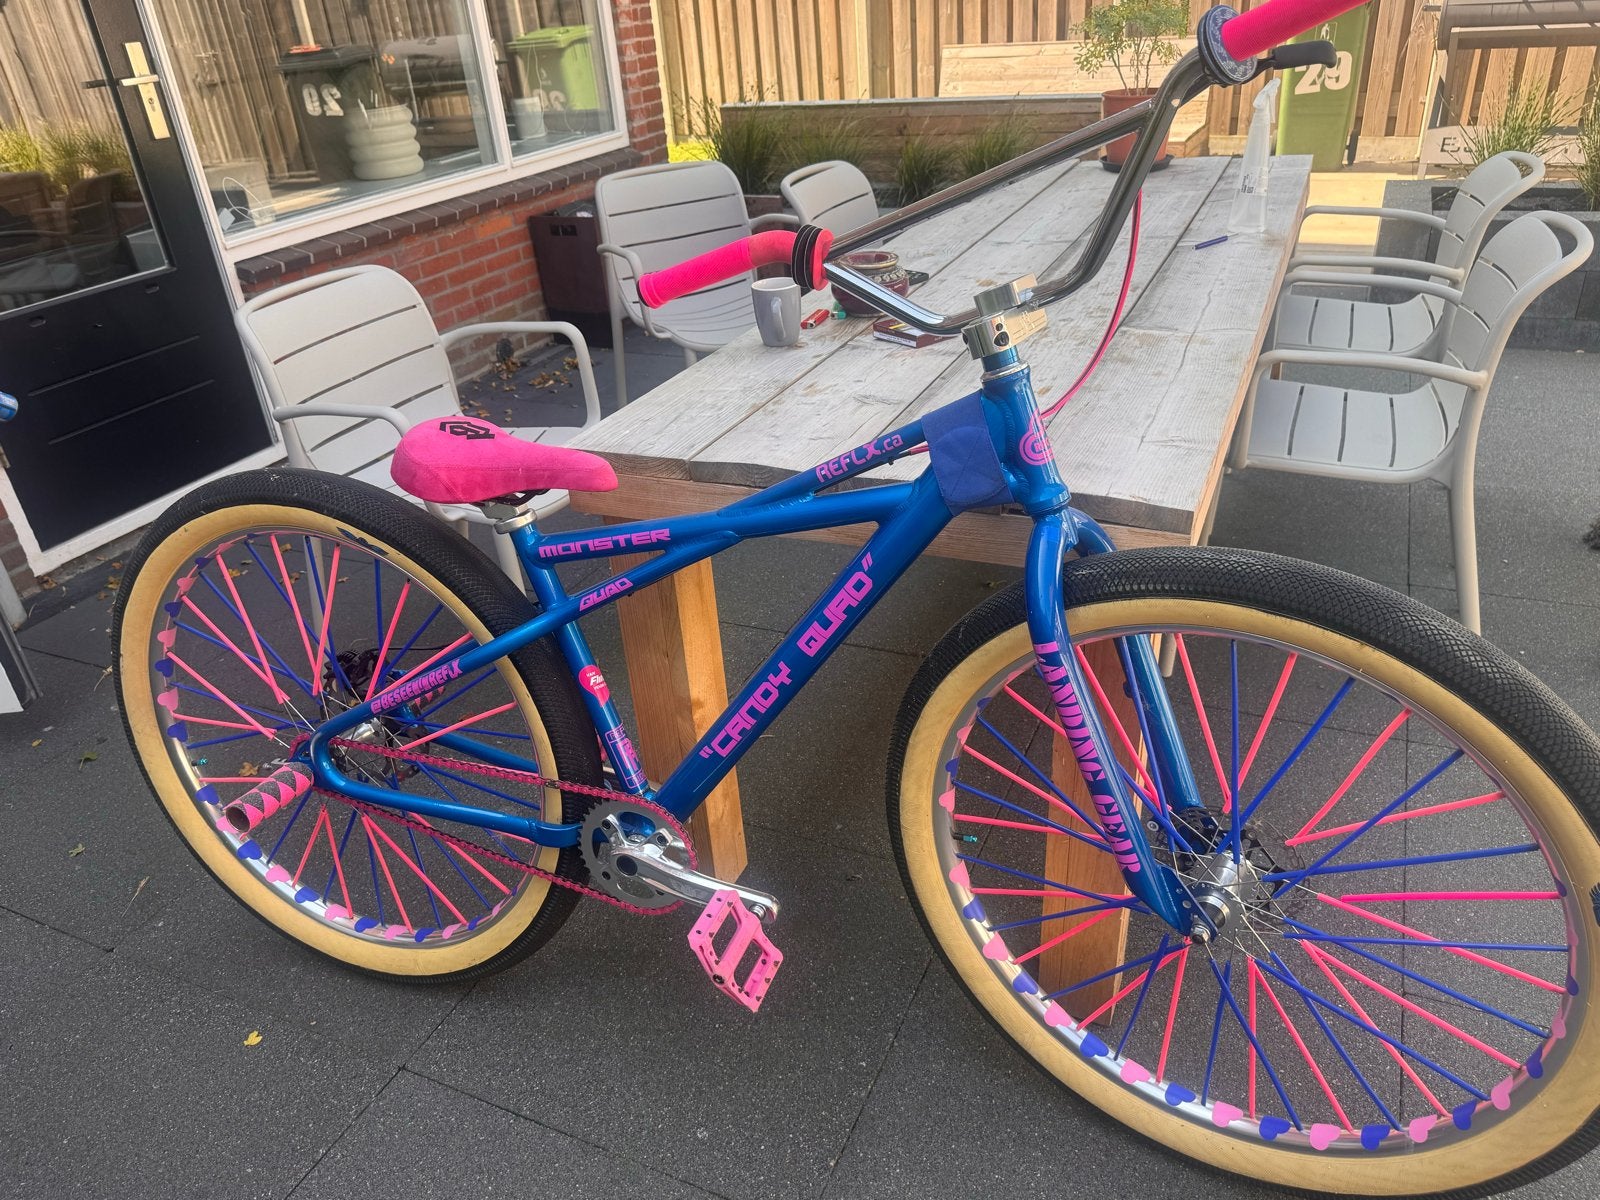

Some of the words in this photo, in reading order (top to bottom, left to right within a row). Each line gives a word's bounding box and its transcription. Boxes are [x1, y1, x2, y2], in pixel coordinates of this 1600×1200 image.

[1294, 51, 1353, 95] 29
[815, 434, 904, 483] REFLX.ca
[538, 528, 671, 558] MONSTER
[579, 577, 634, 612] QUAD
[1032, 640, 1107, 782] LANDING
[1093, 794, 1142, 874] GEAR
